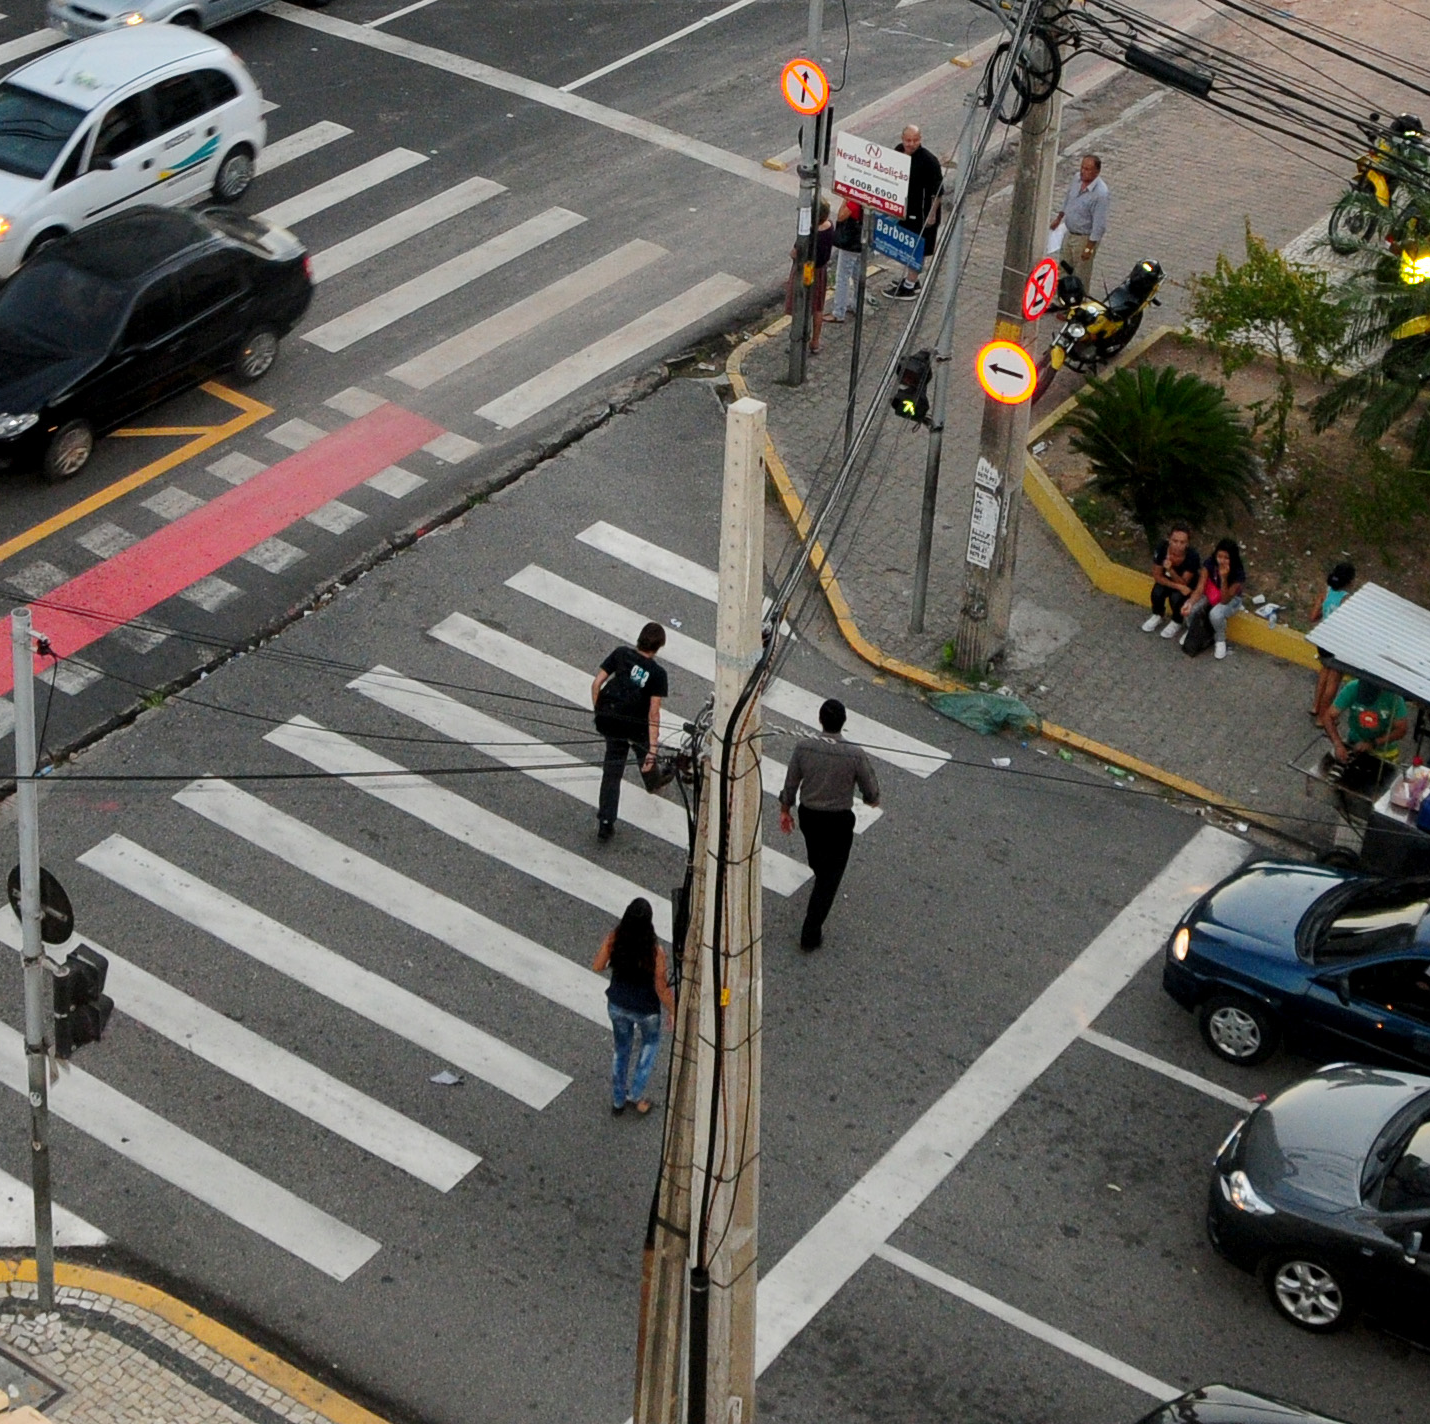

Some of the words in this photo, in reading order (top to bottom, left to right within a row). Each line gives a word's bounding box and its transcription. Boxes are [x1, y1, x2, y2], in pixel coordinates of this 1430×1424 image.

[837, 148, 872, 168] Newland
[873, 160, 909, 182] Abolição
[849, 178, 898, 201] 4008.6900
[876, 218, 915, 249] Barbosa
